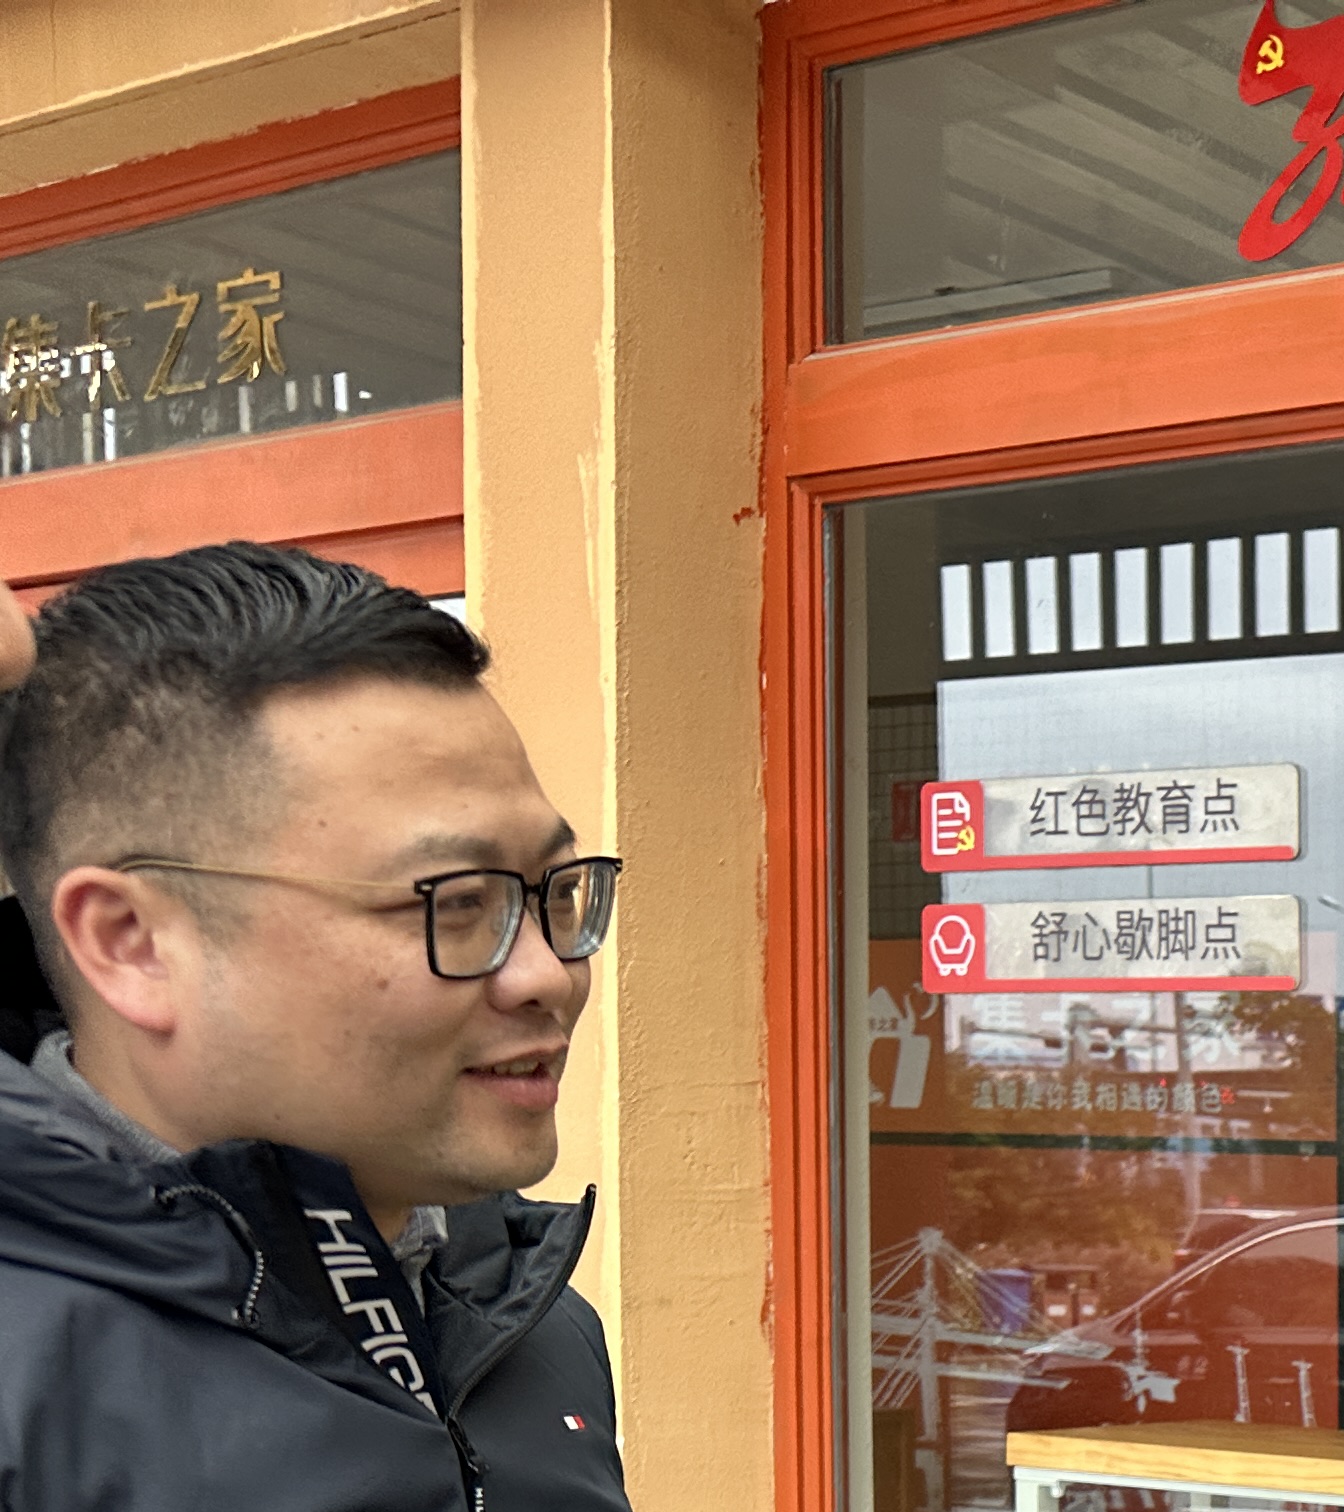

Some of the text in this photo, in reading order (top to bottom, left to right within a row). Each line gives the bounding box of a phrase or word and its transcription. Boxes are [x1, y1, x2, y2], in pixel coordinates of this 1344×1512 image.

[1028, 777, 1240, 838] 红色教育点
[1030, 905, 1242, 964] 舒心歇脚点
[304, 1207, 439, 1417] HILFIG
